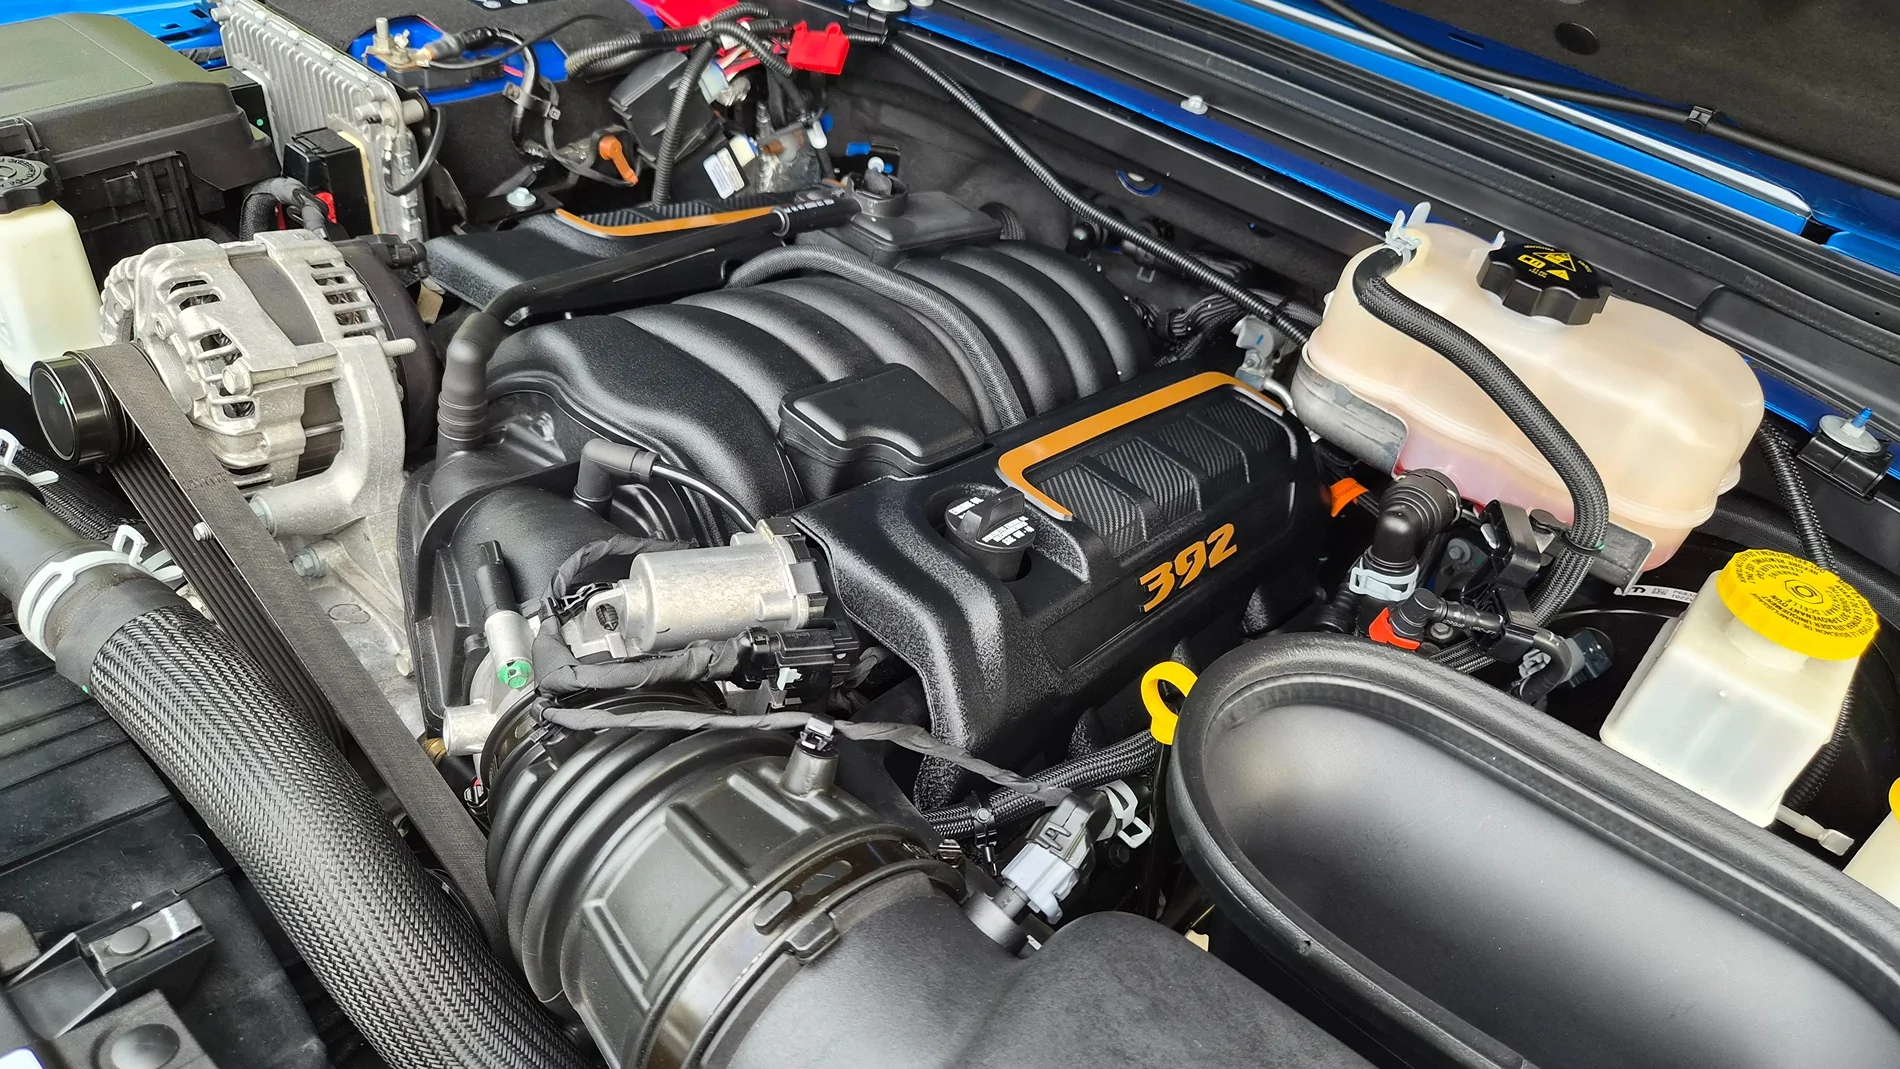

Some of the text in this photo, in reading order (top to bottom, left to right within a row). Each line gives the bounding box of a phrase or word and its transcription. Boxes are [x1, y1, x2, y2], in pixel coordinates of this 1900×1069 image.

[1140, 523, 1237, 612] 392
[1810, 564, 1826, 574] DOT
[1761, 596, 1812, 625] UNIQUEMENT
[1788, 607, 1840, 624] PROVENANT
